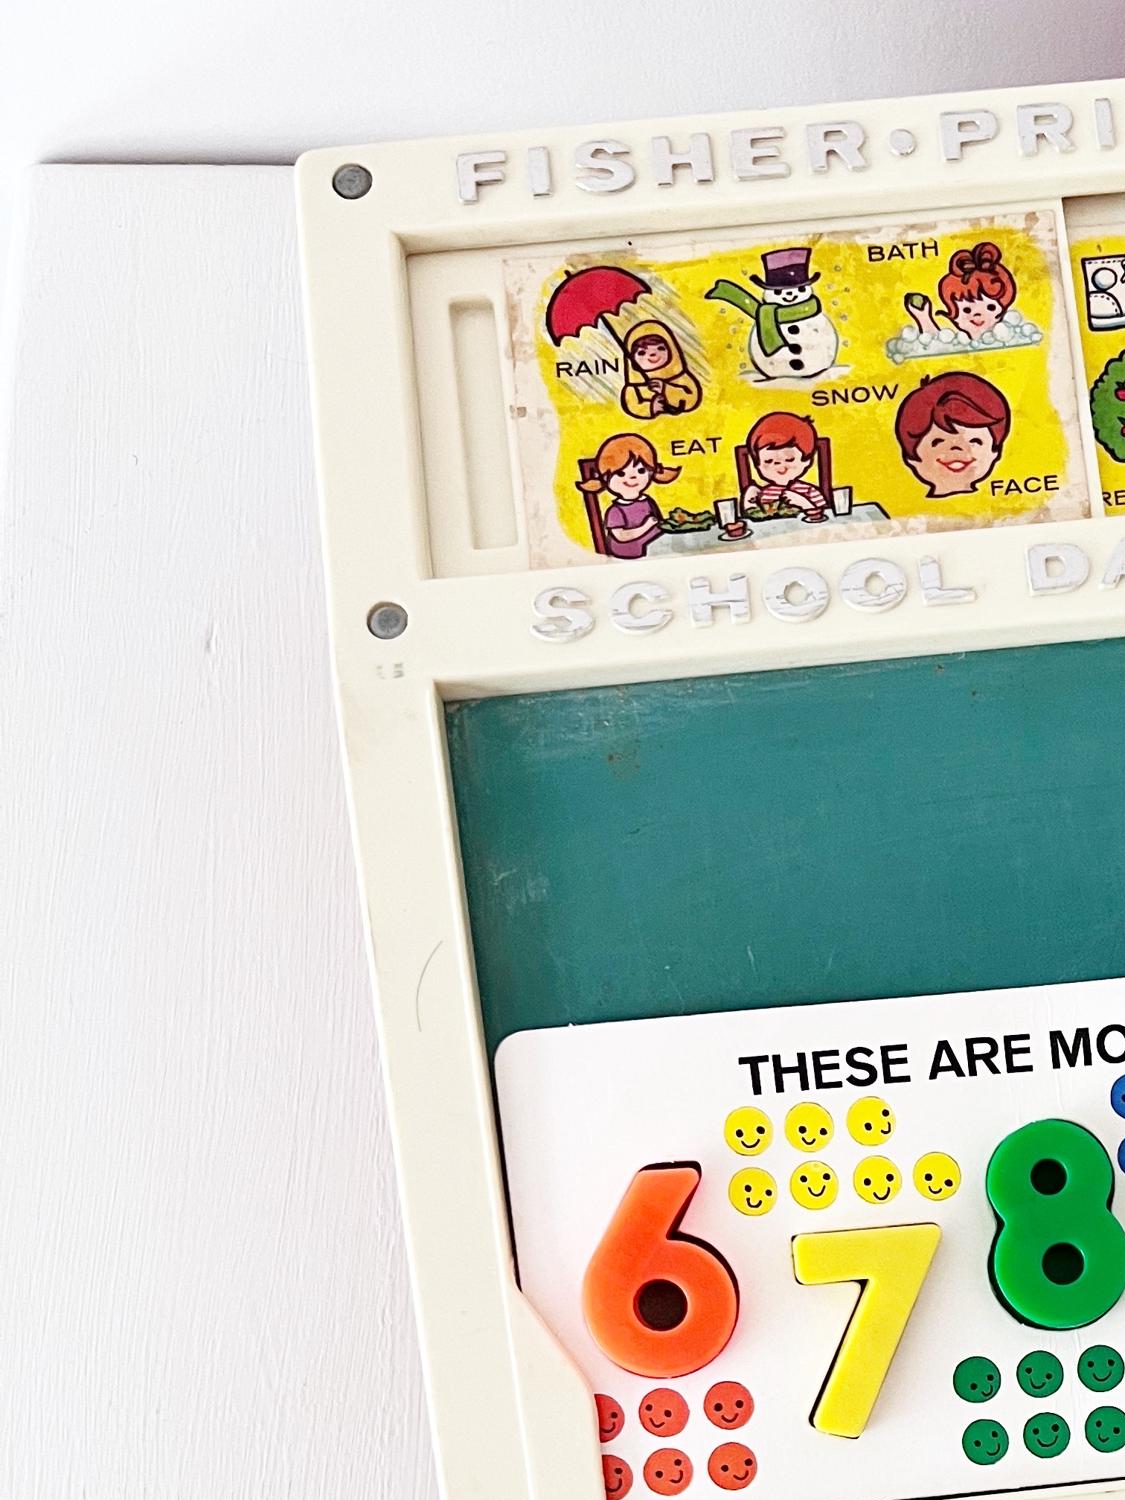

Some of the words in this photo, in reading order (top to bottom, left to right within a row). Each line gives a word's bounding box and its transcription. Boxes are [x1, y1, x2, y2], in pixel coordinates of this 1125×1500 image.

[867, 240, 940, 262] BATH
[555, 357, 621, 379] RAIN
[811, 383, 899, 408] SNOW
[670, 438, 723, 457] EAT
[990, 475, 1060, 497] FACE
[530, 556, 976, 643] SCHOOL
[738, 1044, 911, 1095] THESE
[928, 1034, 1033, 1080] ARE
[583, 1162, 740, 1379] 6
[793, 1224, 942, 1438] 7
